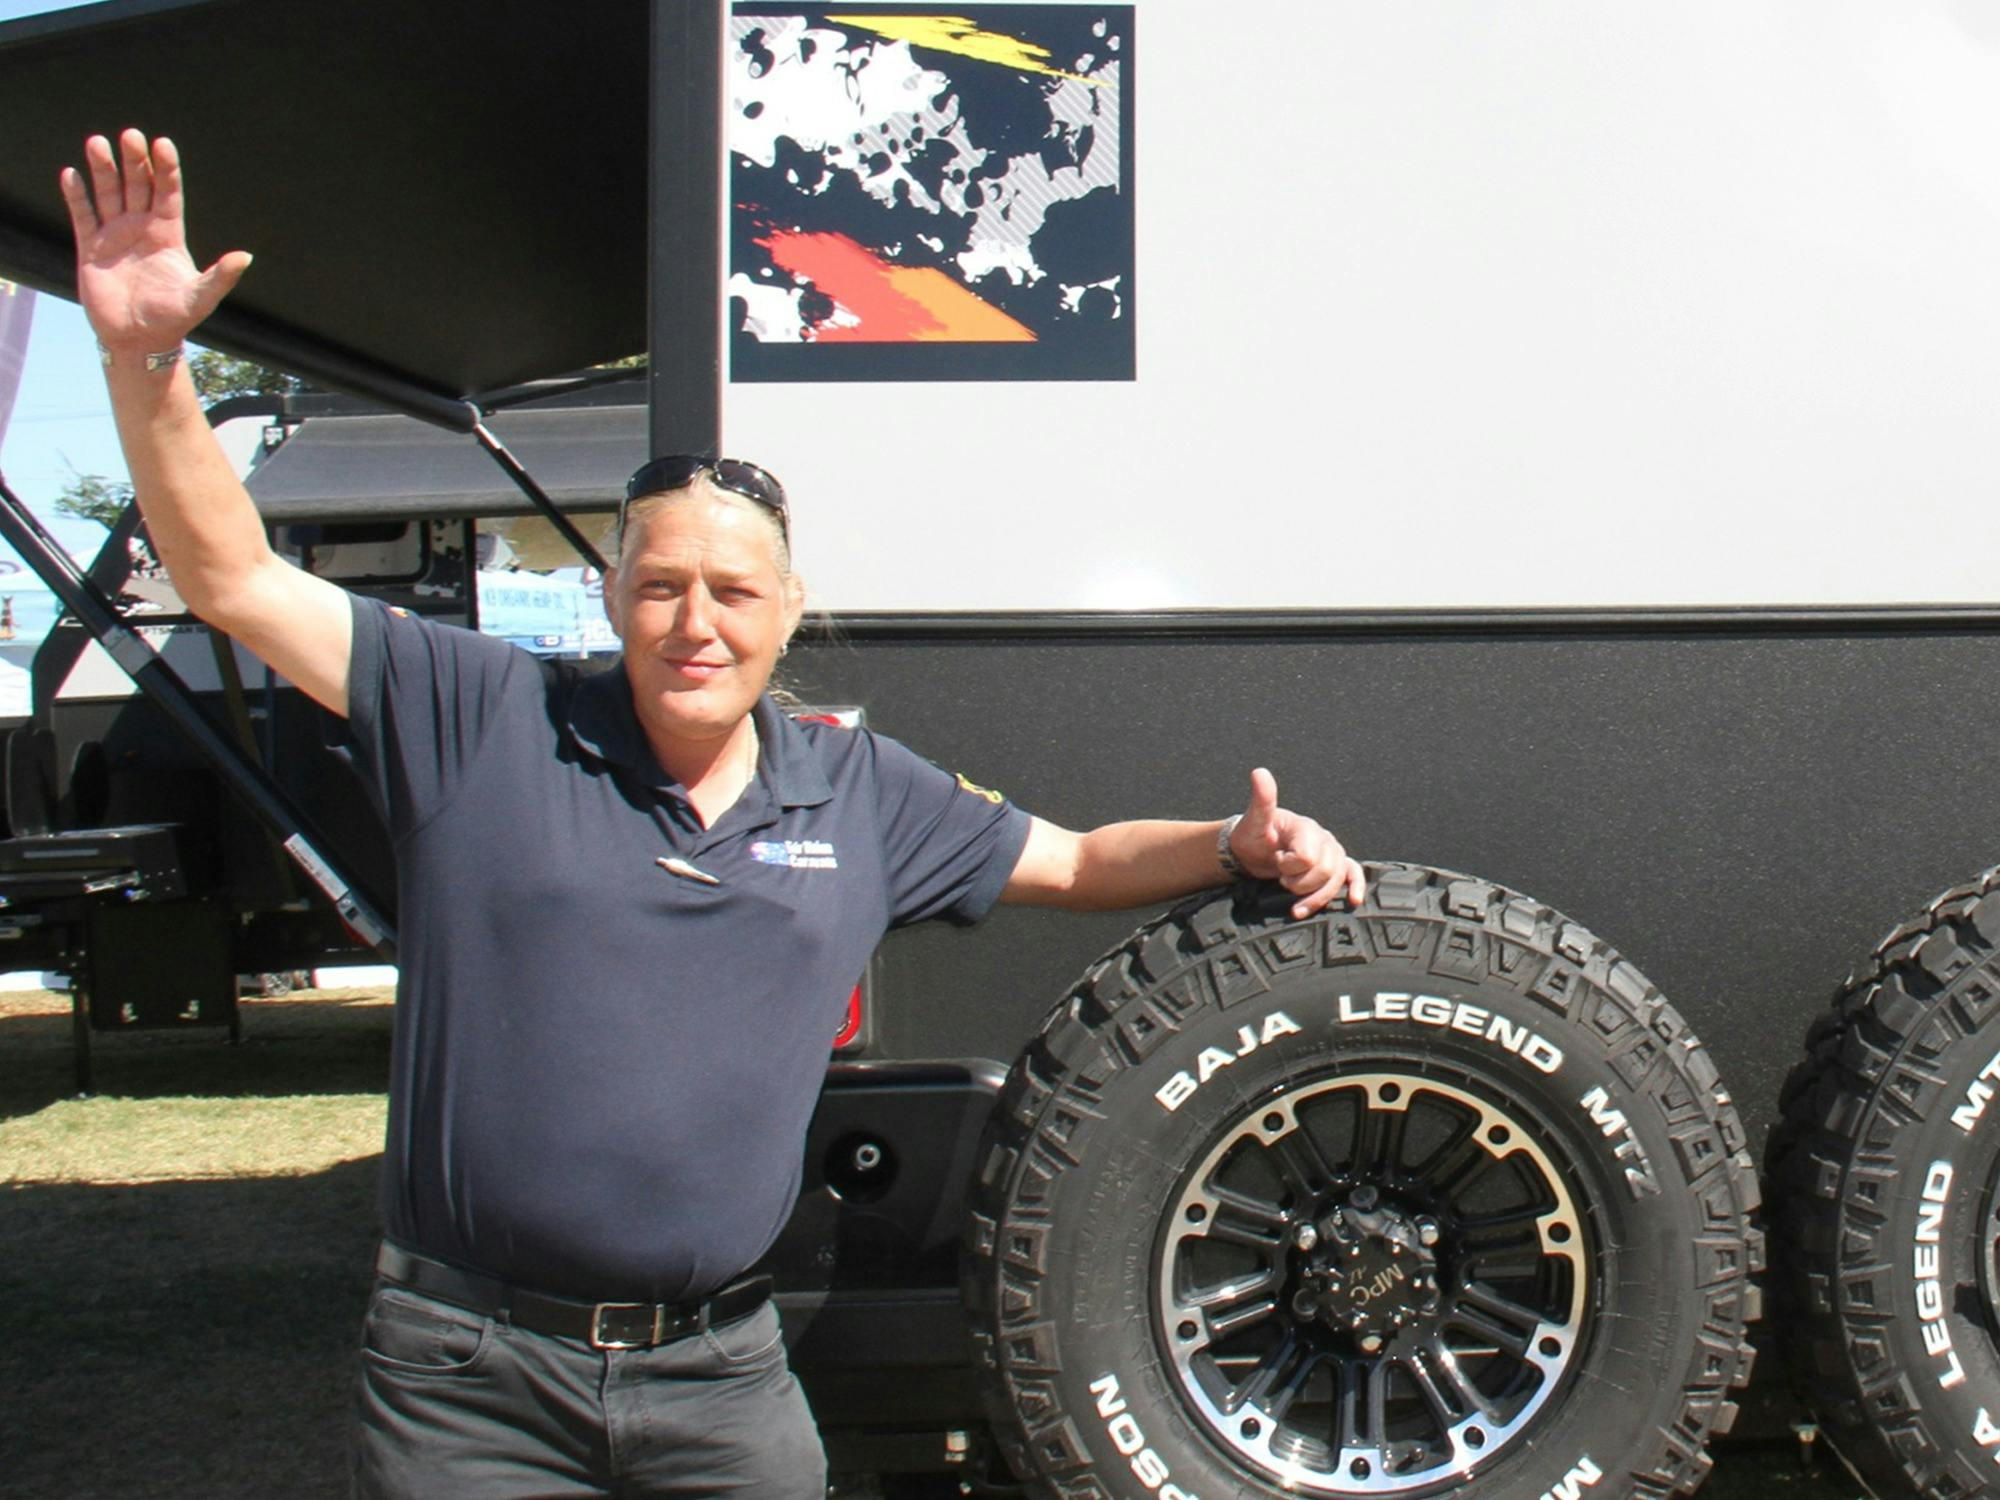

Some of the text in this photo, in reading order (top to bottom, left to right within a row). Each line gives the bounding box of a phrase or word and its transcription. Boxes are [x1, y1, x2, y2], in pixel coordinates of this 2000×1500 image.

[1155, 993, 1662, 1201] BAJA LEGEND MTZ
[1915, 1160, 1967, 1387] LEGEND
